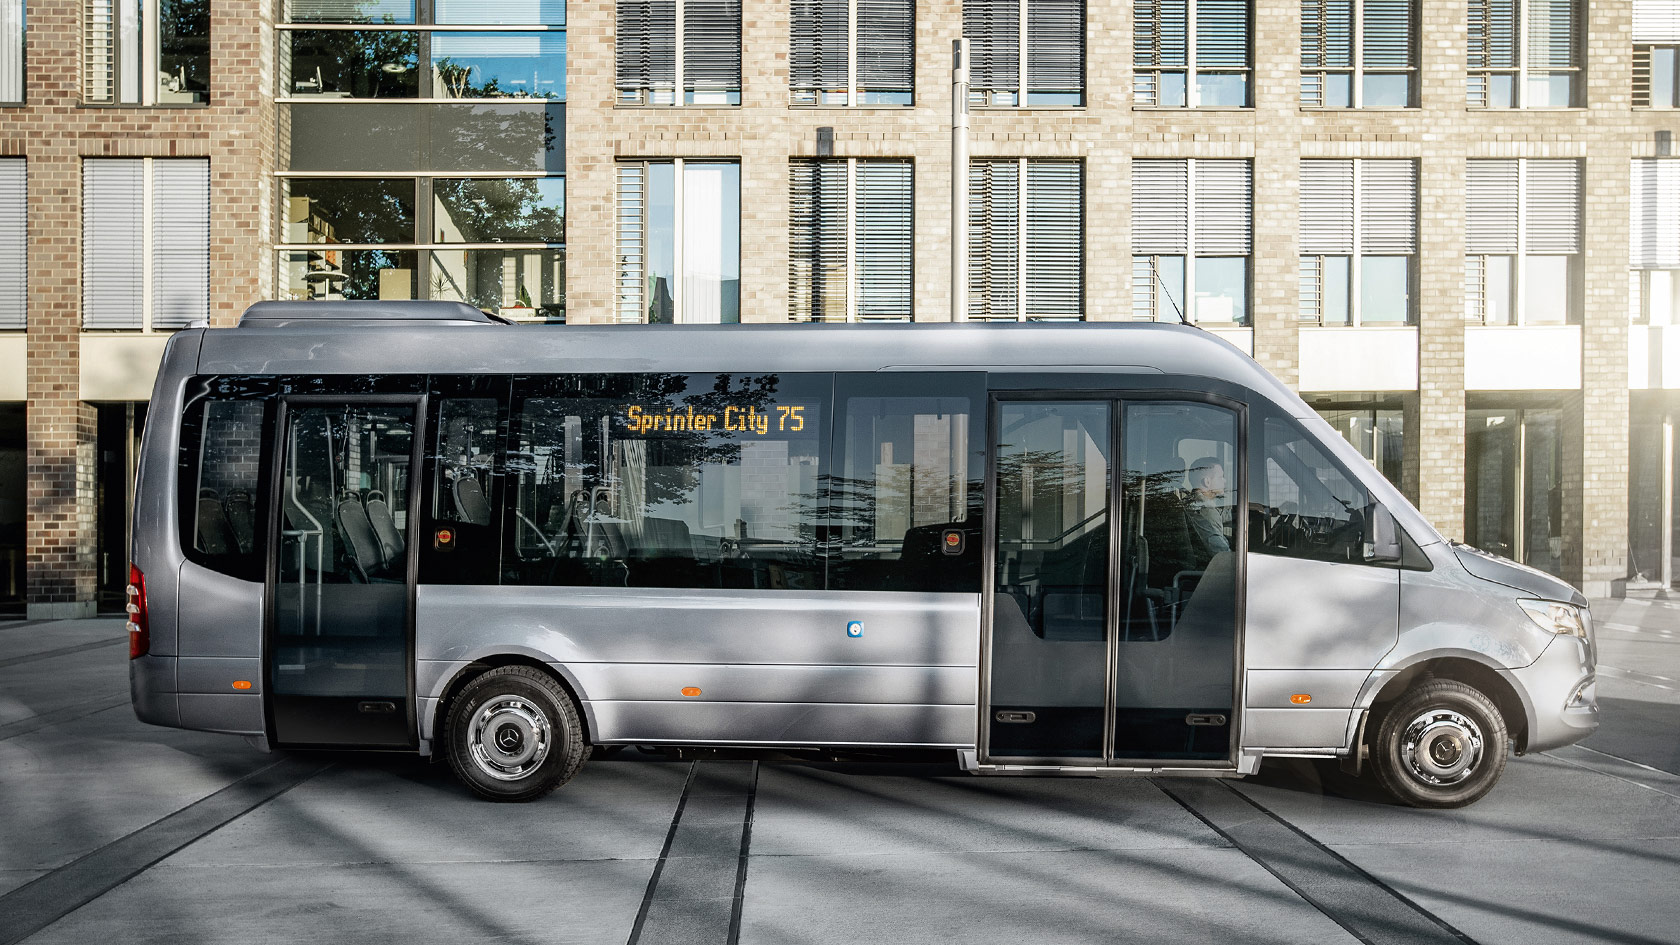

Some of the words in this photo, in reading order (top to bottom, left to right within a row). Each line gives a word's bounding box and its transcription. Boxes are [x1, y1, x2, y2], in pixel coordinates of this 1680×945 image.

[627, 405, 717, 434] Sprinter
[724, 405, 768, 434] City
[777, 405, 804, 431] 75
